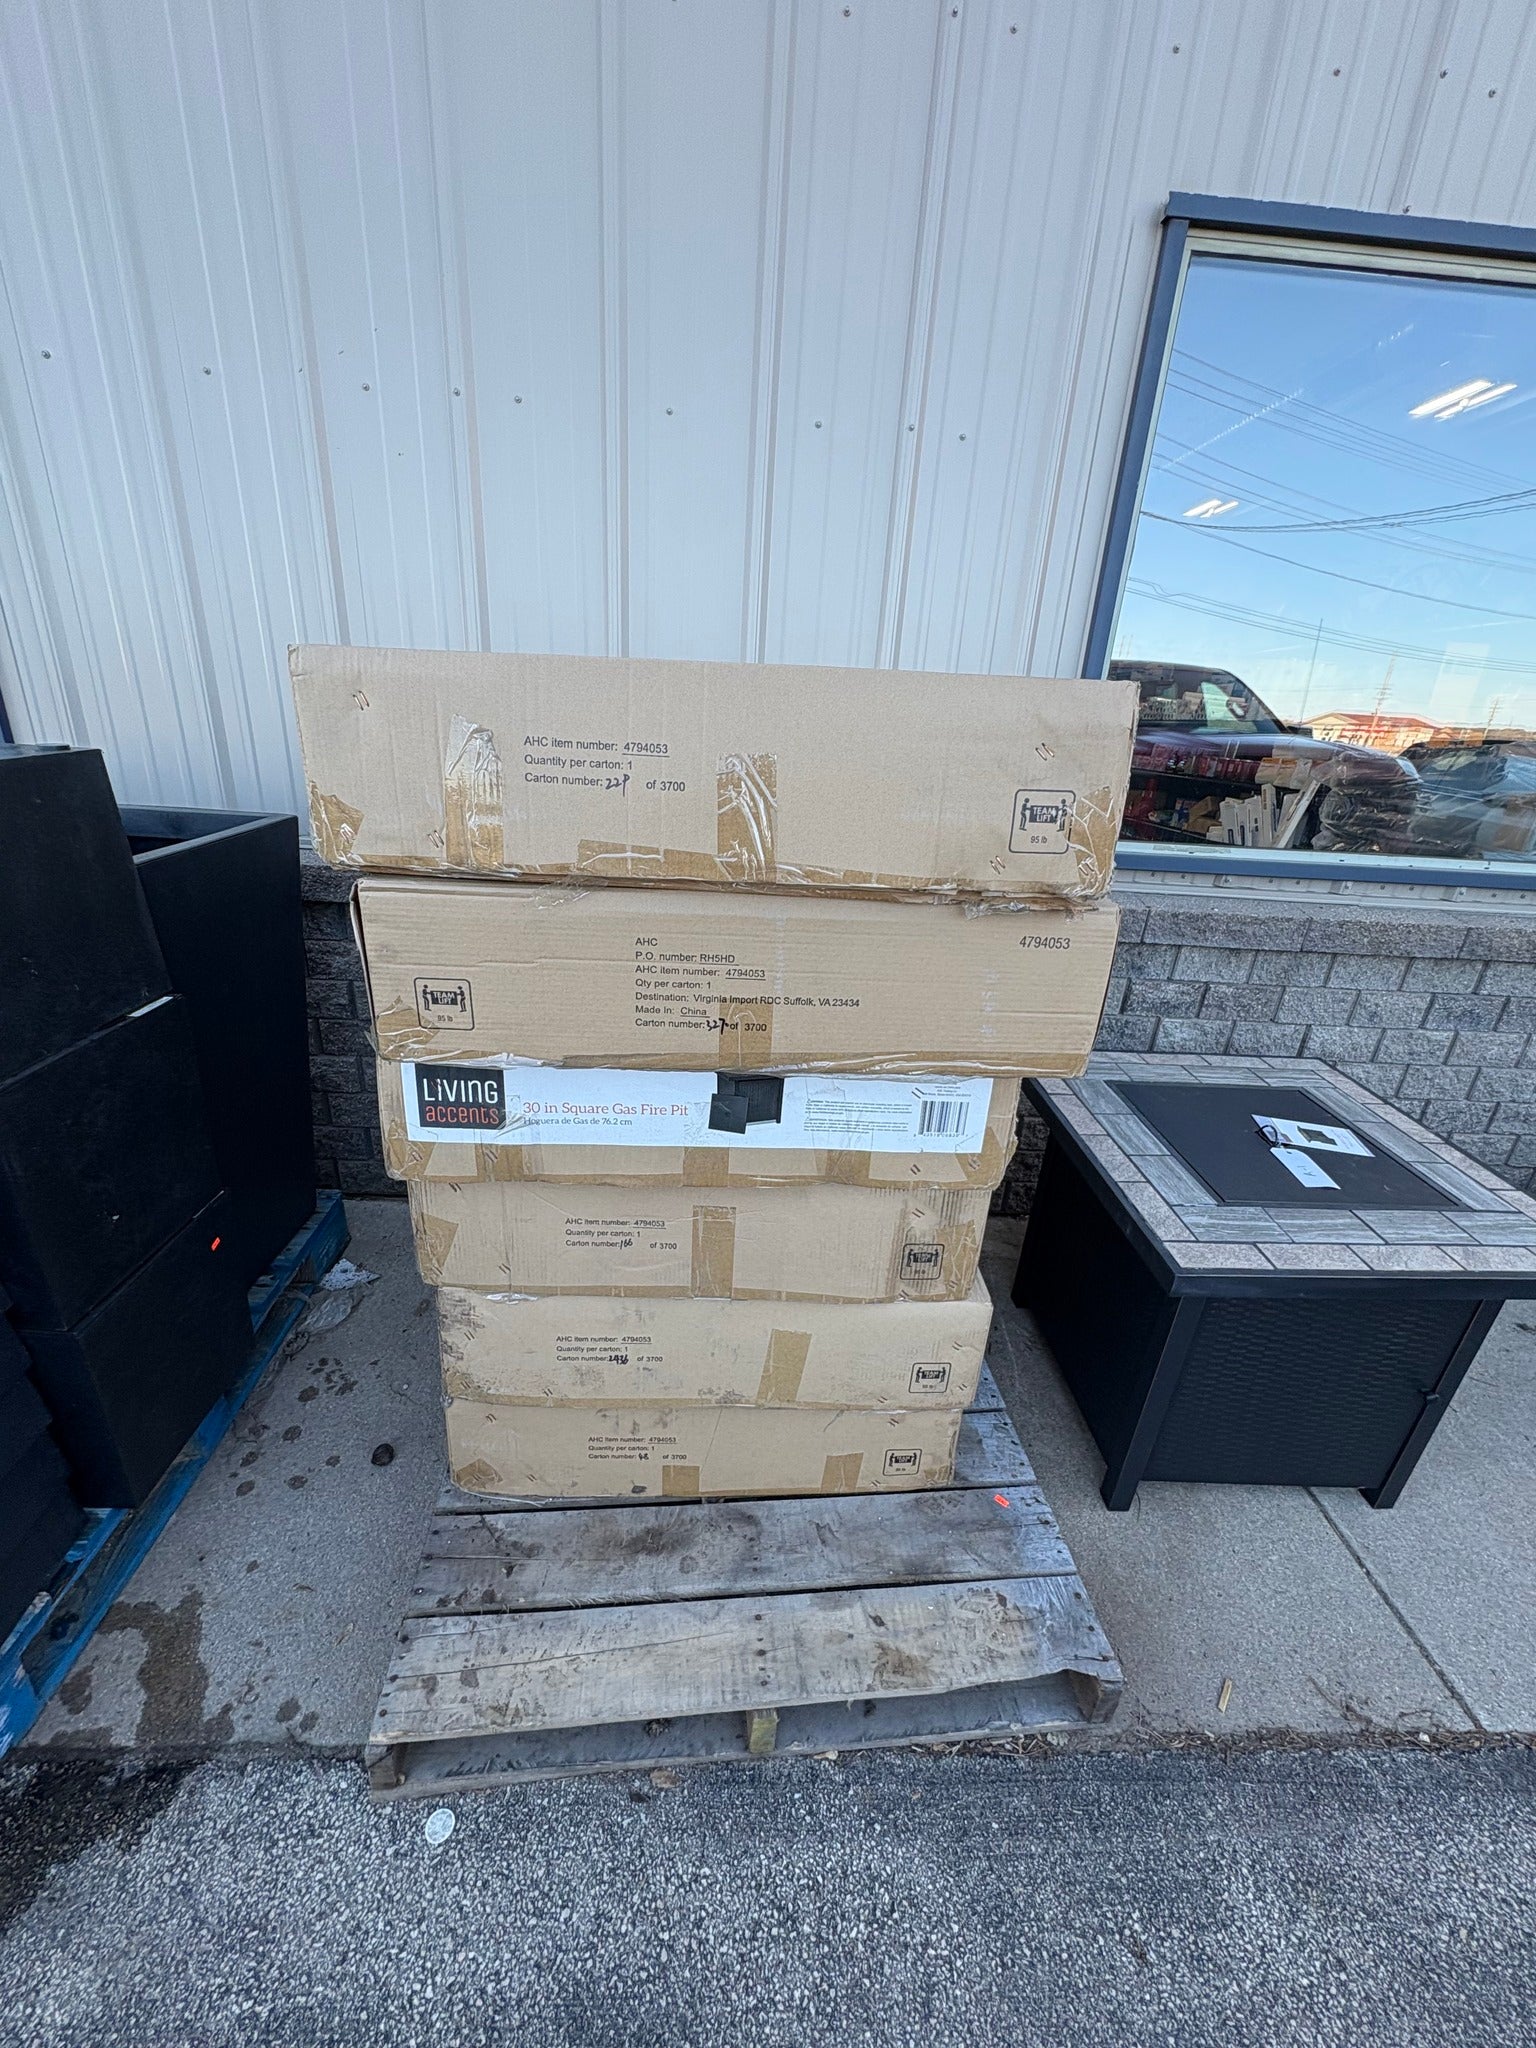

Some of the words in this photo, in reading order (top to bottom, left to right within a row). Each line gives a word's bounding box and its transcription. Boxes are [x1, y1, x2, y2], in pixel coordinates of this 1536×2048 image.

[524, 736, 548, 747] AHC
[551, 737, 573, 749] item
[576, 739, 618, 751] number:
[624, 742, 668, 754] 4794053
[524, 754, 567, 769] Quantity
[570, 758, 586, 769] per
[589, 760, 624, 770] carton:
[627, 761, 633, 770] 1
[525, 772, 559, 784] Carton
[562, 775, 603, 787] number:
[646, 780, 657, 790] of
[660, 781, 686, 792] 3700
[1033, 807, 1056, 815] TEAM
[1036, 814, 1052, 822] LIFT
[1030, 835, 1040, 844] 95
[1041, 835, 1048, 844] lb
[635, 938, 658, 947] AHC
[1019, 935, 1071, 950] 4794053
[635, 952, 656, 961] P.O.
[659, 953, 697, 962] number:
[700, 954, 735, 963] RH5HD
[635, 965, 658, 974] AHC
[660, 966, 680, 975] item
[682, 967, 720, 977] number:
[725, 969, 766, 978] 4794053
[635, 979, 652, 989] Qty
[654, 981, 670, 989] per
[671, 981, 704, 989] carton:
[438, 997, 452, 1005] LIFT
[635, 992, 689, 1002] Destination:
[693, 994, 727, 1005] Virginia
[729, 996, 758, 1006] Import
[760, 996, 781, 1005] RDC
[783, 997, 817, 1007] Suffolk,
[818, 998, 831, 1007] VA
[832, 999, 860, 1007] 23434
[635, 1005, 661, 1014] Made
[663, 1007, 675, 1015] In:
[680, 1007, 707, 1016] China
[635, 1019, 666, 1028] Carton
[668, 1019, 706, 1029] number:
[729, 1022, 739, 1031] of
[744, 1023, 767, 1031] 3700
[426, 1105, 500, 1124] accents
[523, 1102, 541, 1114] 30
[544, 1102, 558, 1114] in
[562, 1102, 609, 1116] Square
[612, 1103, 637, 1115] Gas
[640, 1104, 667, 1116] Fire
[670, 1104, 688, 1116] Pit
[523, 1117, 560, 1126] Hoguera
[561, 1117, 571, 1125] de
[573, 1117, 589, 1125] Gas
[589, 1117, 600, 1125] de
[601, 1117, 619, 1126] 76.2
[565, 1229, 596, 1237] Quantity
[556, 1345, 584, 1353] Quantity
